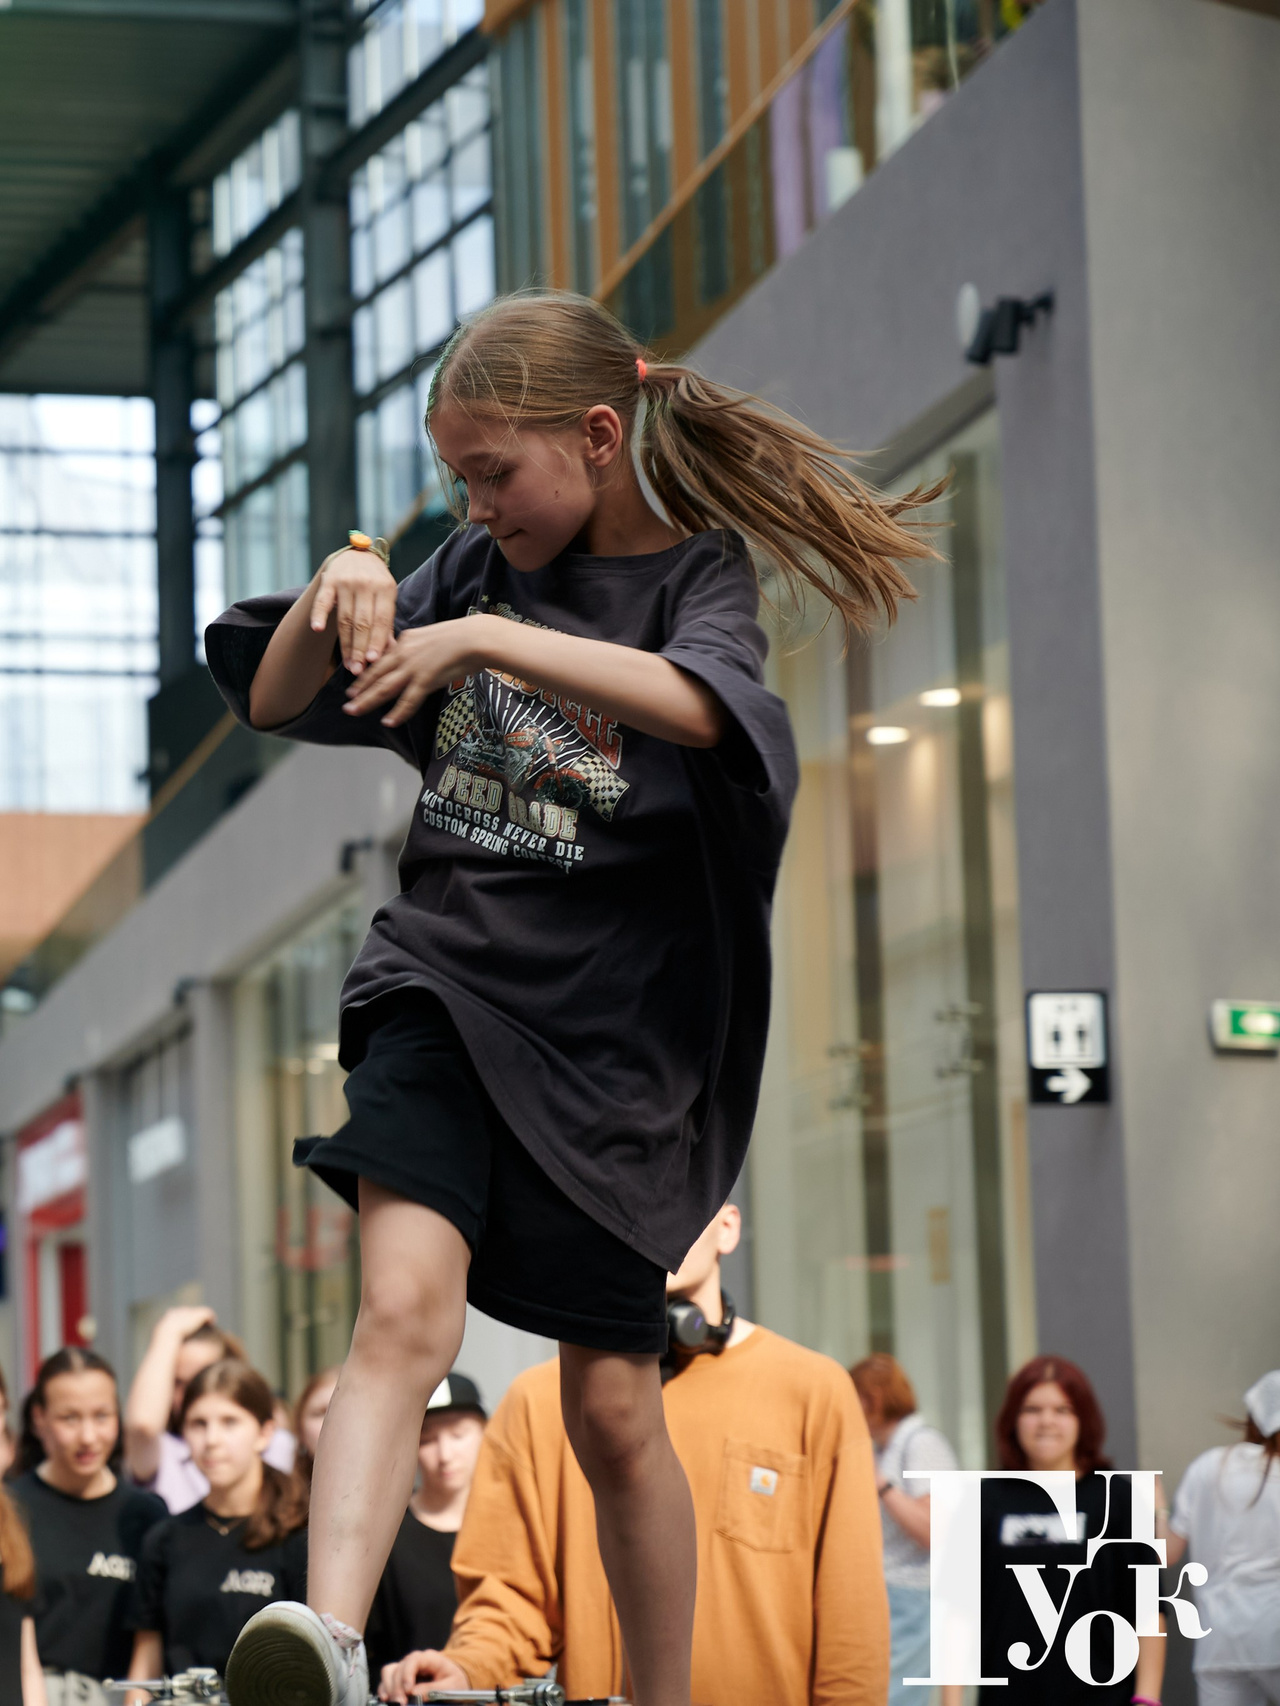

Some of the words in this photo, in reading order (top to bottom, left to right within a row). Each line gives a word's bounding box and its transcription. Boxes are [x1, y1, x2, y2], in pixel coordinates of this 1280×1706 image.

[421, 788, 500, 832] MOTOCROSS
[503, 822, 547, 852] NEVER
[555, 841, 585, 861] DIE
[423, 809, 470, 839] CUSTOM
[470, 826, 509, 856] SPRING
